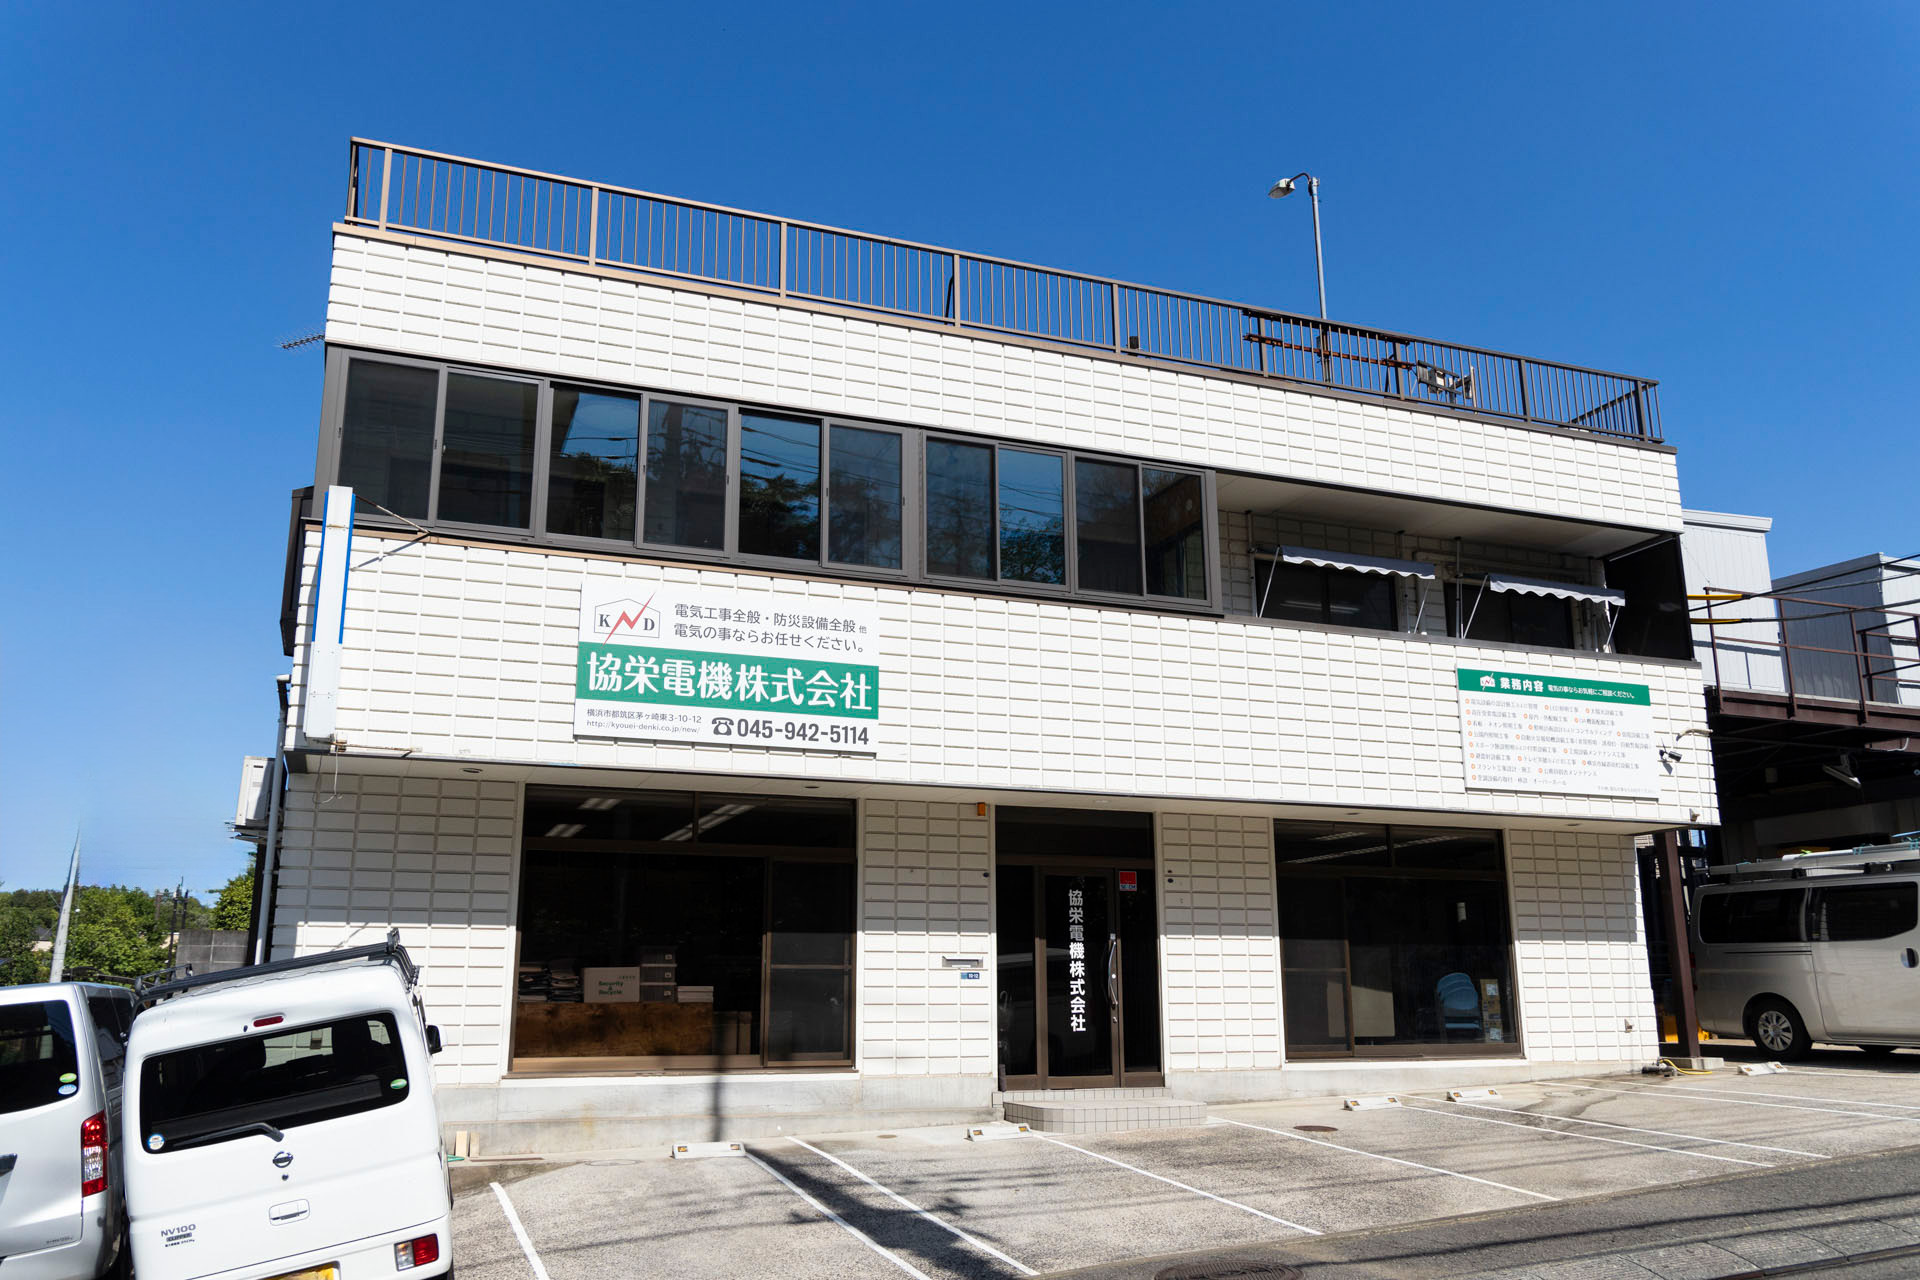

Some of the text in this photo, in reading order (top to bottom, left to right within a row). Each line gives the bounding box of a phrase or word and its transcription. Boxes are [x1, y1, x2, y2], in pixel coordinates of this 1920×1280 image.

[674, 603, 856, 633] 電気工事全般・防災設備全般
[673, 623, 864, 653] 電気の事ならお任せください。
[586, 651, 872, 710] 協栄電機株式会社
[737, 718, 869, 745] 045-942-5114
[1068, 889, 1086, 1032] 協栄電機株式会社
[160, 1223, 196, 1237] NV100
